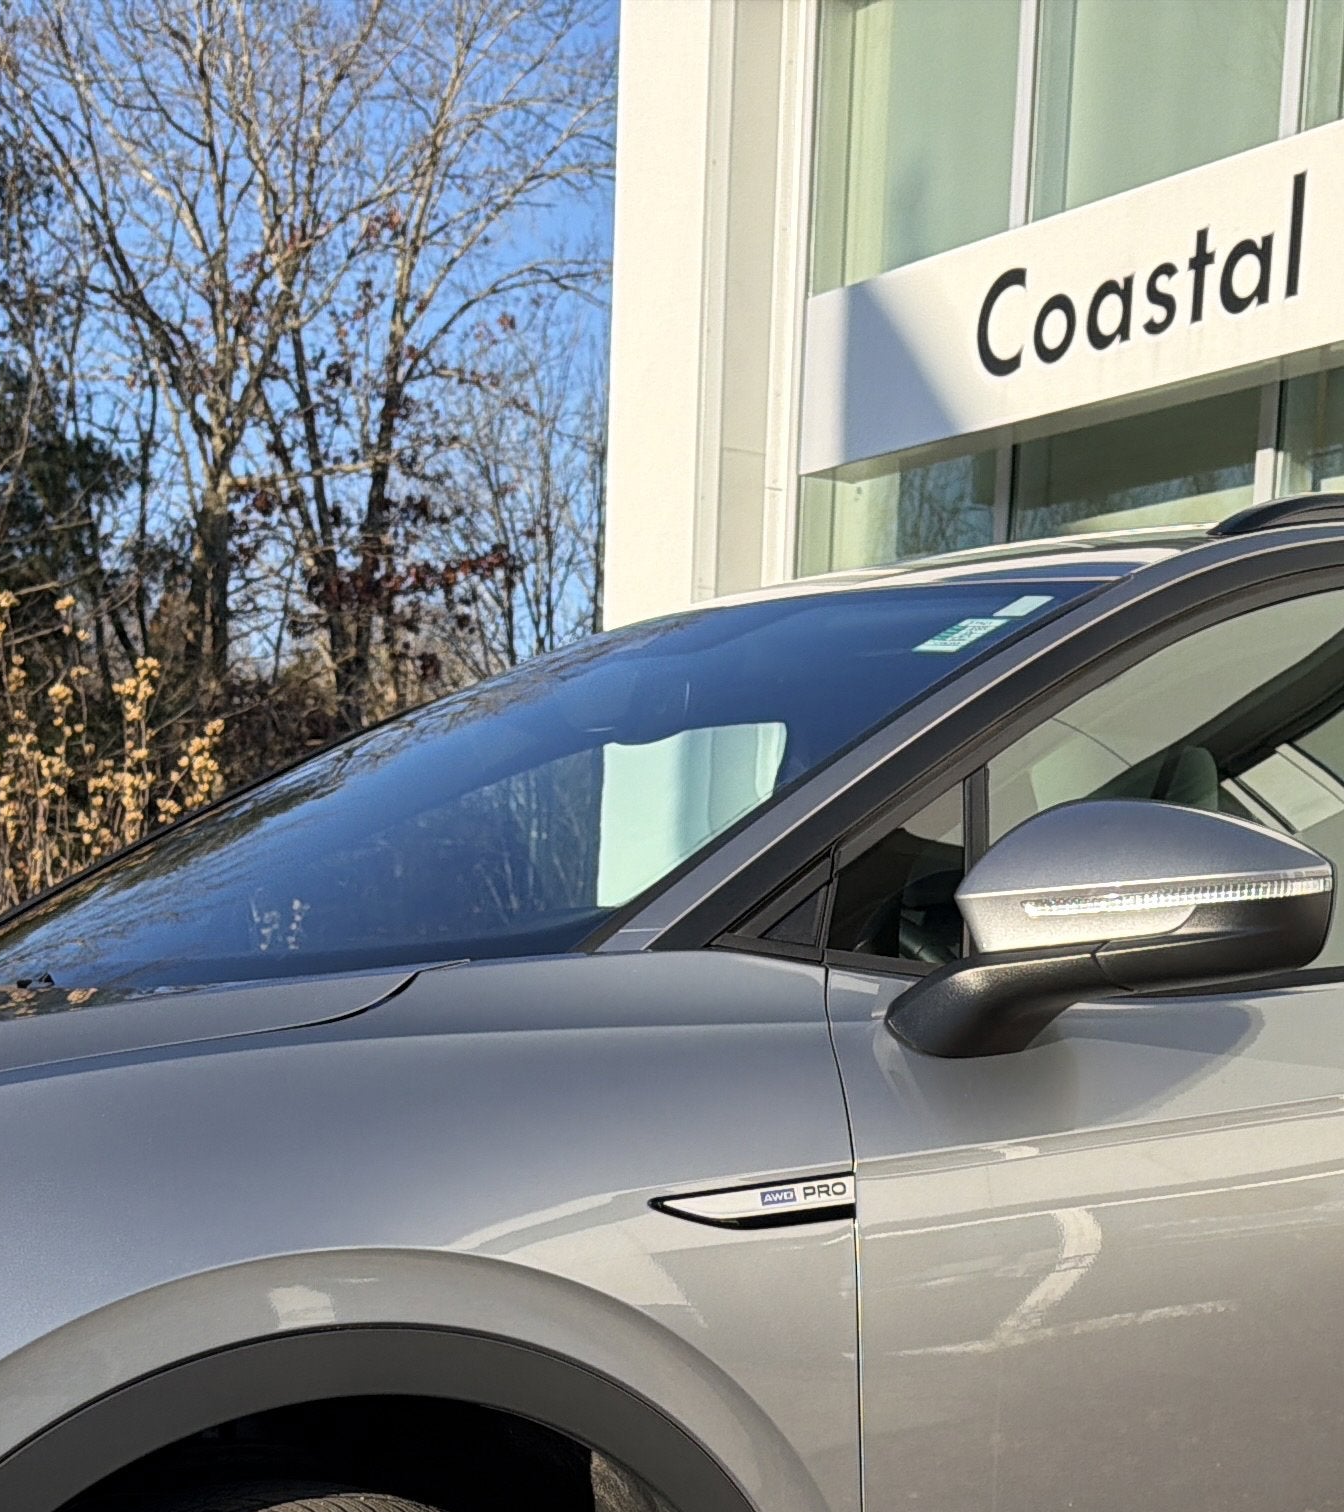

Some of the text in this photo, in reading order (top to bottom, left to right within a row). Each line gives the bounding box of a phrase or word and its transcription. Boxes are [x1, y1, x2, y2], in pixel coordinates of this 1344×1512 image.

[977, 169, 1308, 377] Coastal
[762, 1182, 847, 1204] AWD PRO
